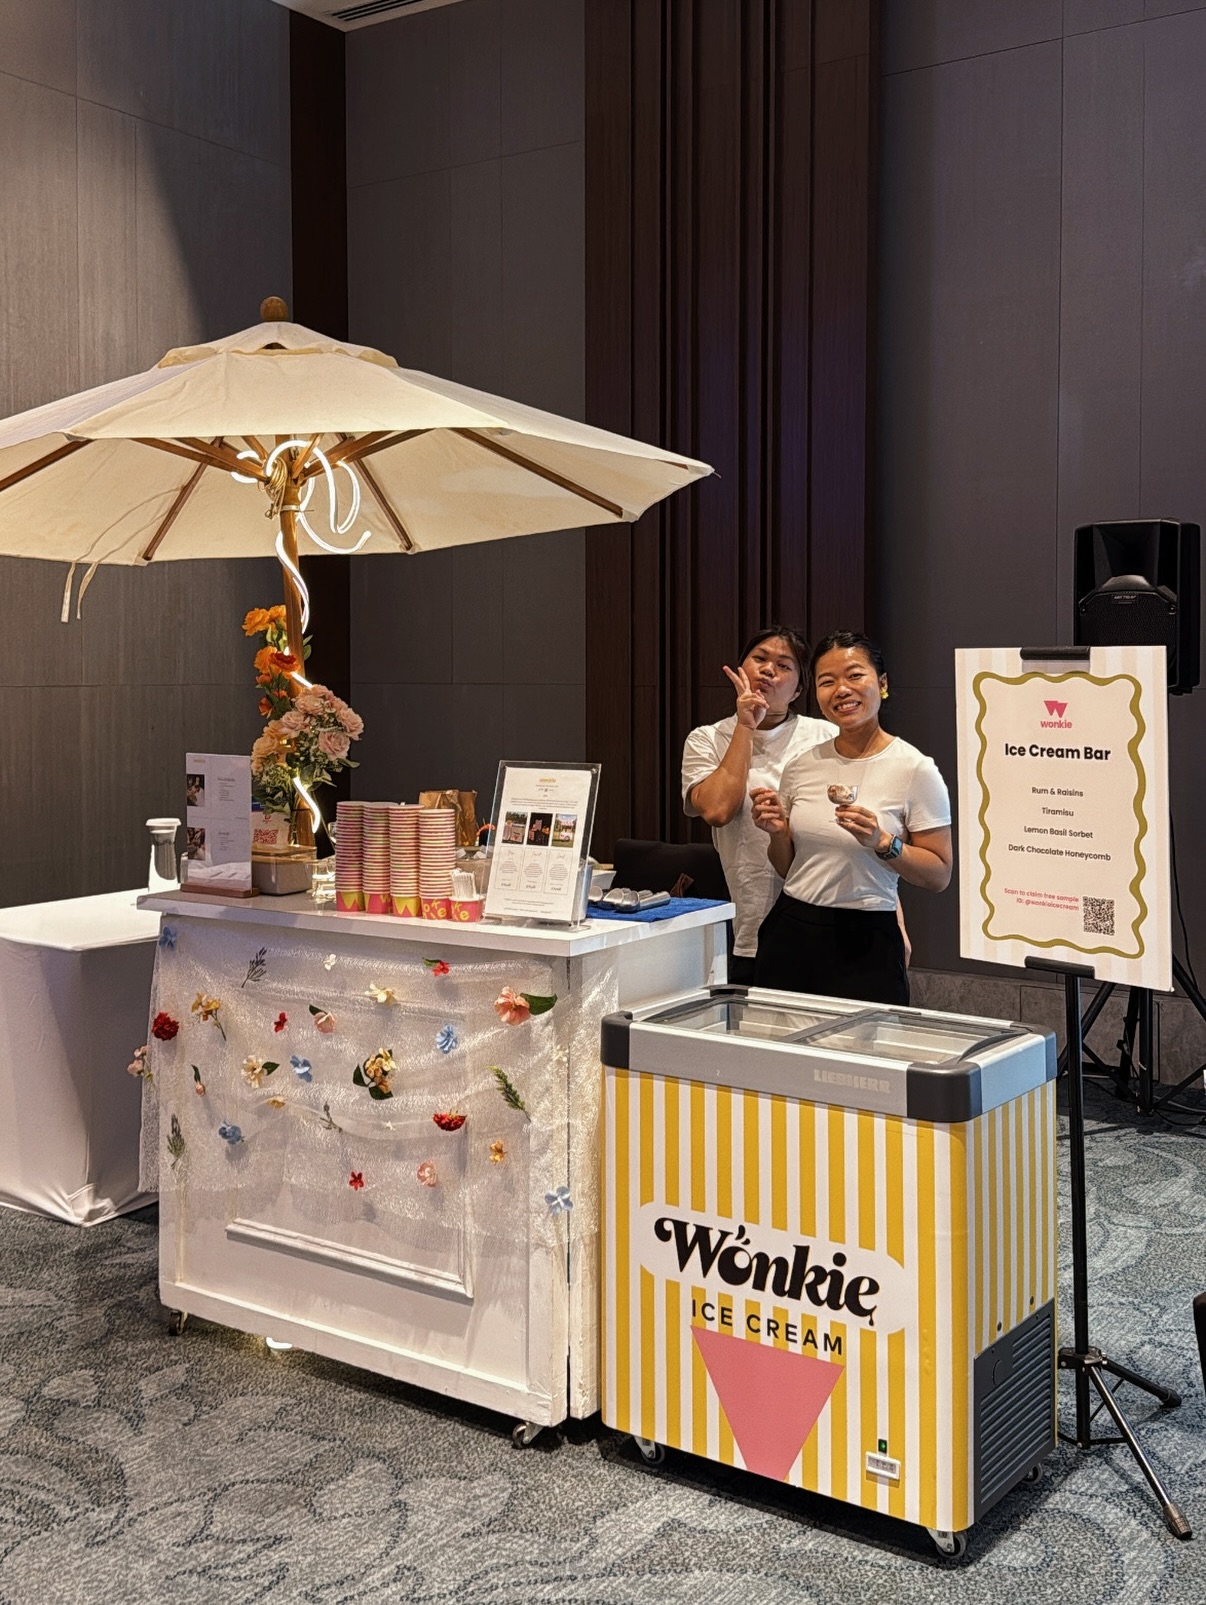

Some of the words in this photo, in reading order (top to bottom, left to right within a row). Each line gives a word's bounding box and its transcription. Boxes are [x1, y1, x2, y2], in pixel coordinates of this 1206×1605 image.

[1040, 720, 1073, 729] wonkie
[1005, 743, 1027, 757] Ice
[1029, 744, 1080, 759] Cream
[1084, 746, 1111, 760] Bar
[1031, 787, 1049, 795] Rum
[1057, 788, 1084, 797] Raisins
[1041, 807, 1074, 817] Tiramisu
[1024, 826, 1048, 835] Lemon
[1049, 828, 1067, 836] Basil
[1068, 830, 1093, 839] Sorbet
[1008, 844, 1025, 852] Dark
[1026, 846, 1064, 856] Chocolate
[1065, 849, 1111, 861] Honeycomb
[653, 1217, 880, 1326] Wonkie
[692, 1299, 733, 1327] ICE
[746, 1313, 843, 1356] CREAM
